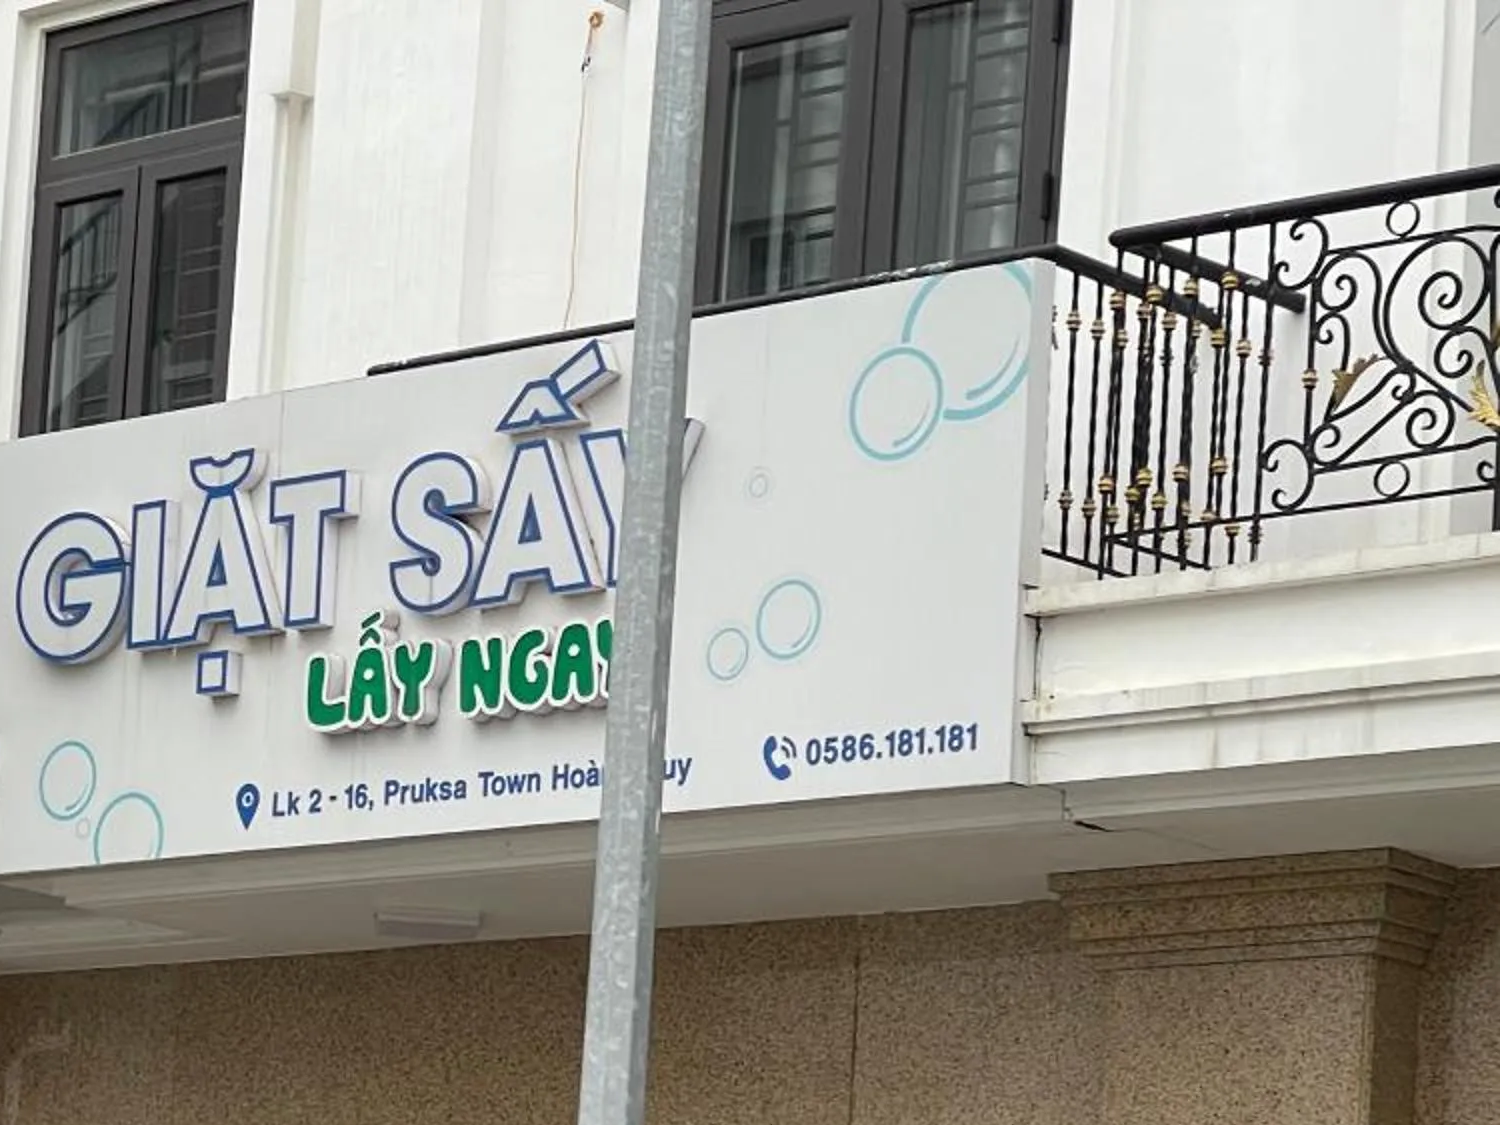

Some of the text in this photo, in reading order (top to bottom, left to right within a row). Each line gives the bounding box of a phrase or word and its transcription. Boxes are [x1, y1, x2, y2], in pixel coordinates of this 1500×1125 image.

[16, 448, 350, 696] GIẶT
[307, 612, 434, 727] LẤY
[271, 791, 300, 817] Lk
[308, 788, 322, 813] 2
[344, 783, 374, 811] 16,
[383, 777, 467, 805] Pruksa
[477, 771, 541, 797] Town
[551, 759, 605, 790] Hoà
[662, 757, 693, 786] uy
[805, 722, 979, 766] 0586.181.181
